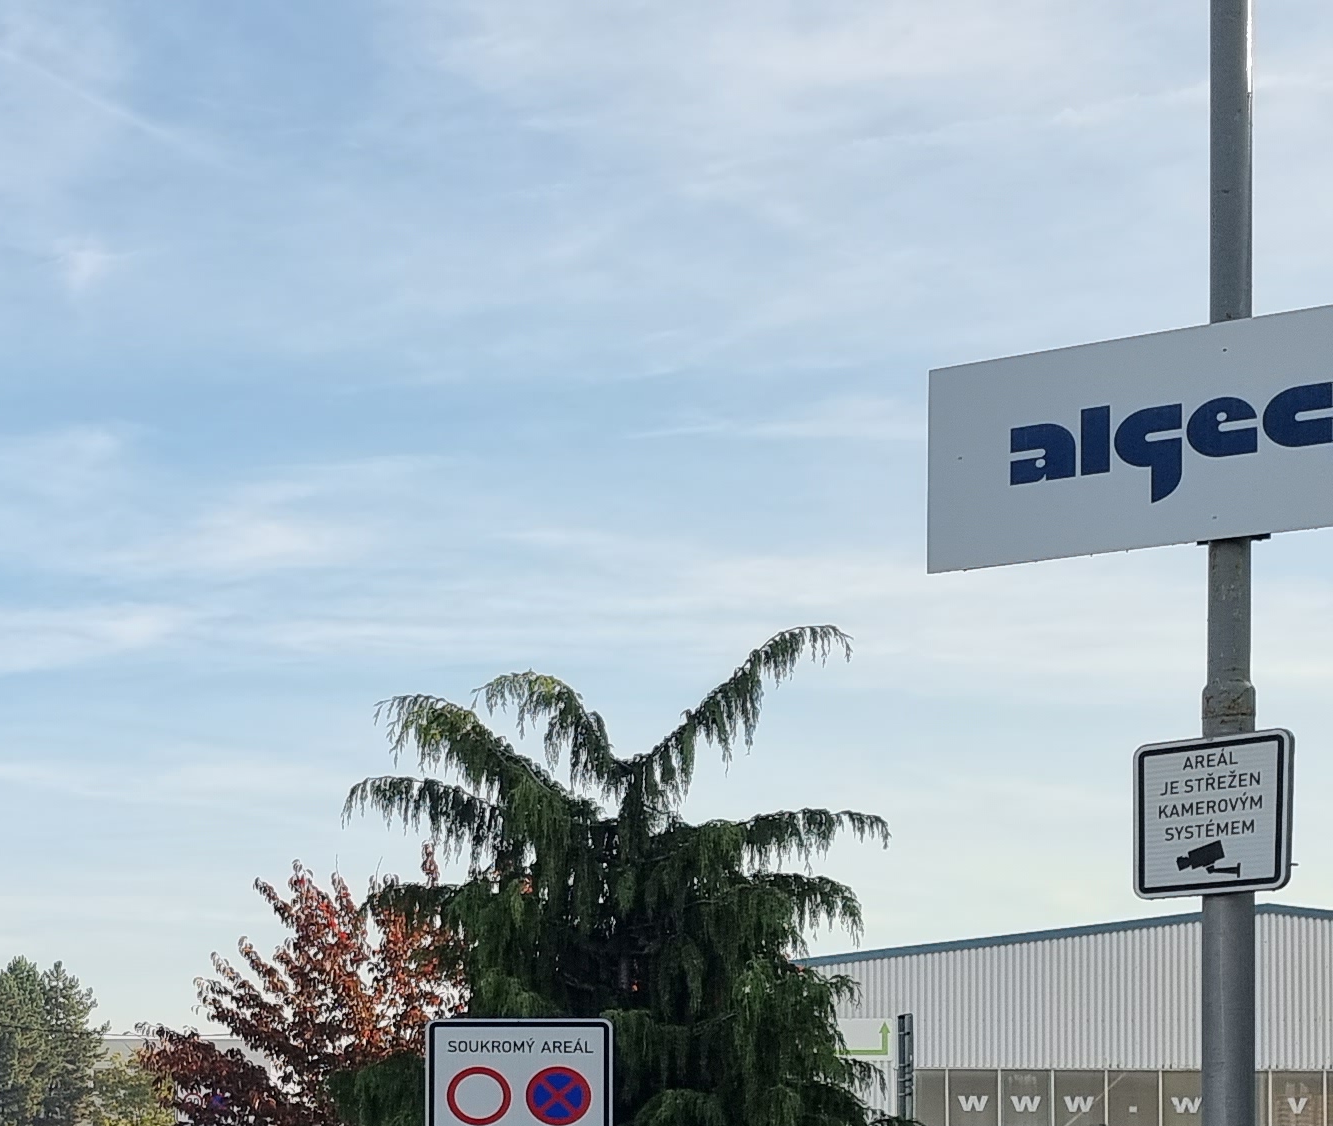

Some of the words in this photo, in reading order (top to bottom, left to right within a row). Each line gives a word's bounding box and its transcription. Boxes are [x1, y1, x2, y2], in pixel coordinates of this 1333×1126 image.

[1183, 748, 1239, 770] AREÁL
[1160, 781, 1180, 796] JE
[1184, 770, 1261, 793] STŘEŽEN
[1158, 792, 1263, 819] KAMEROVÝM
[1165, 819, 1255, 841] SYSTÉMEM
[447, 1038, 535, 1053] SOUKROMÝ
[541, 1038, 594, 1053] AREÁL
